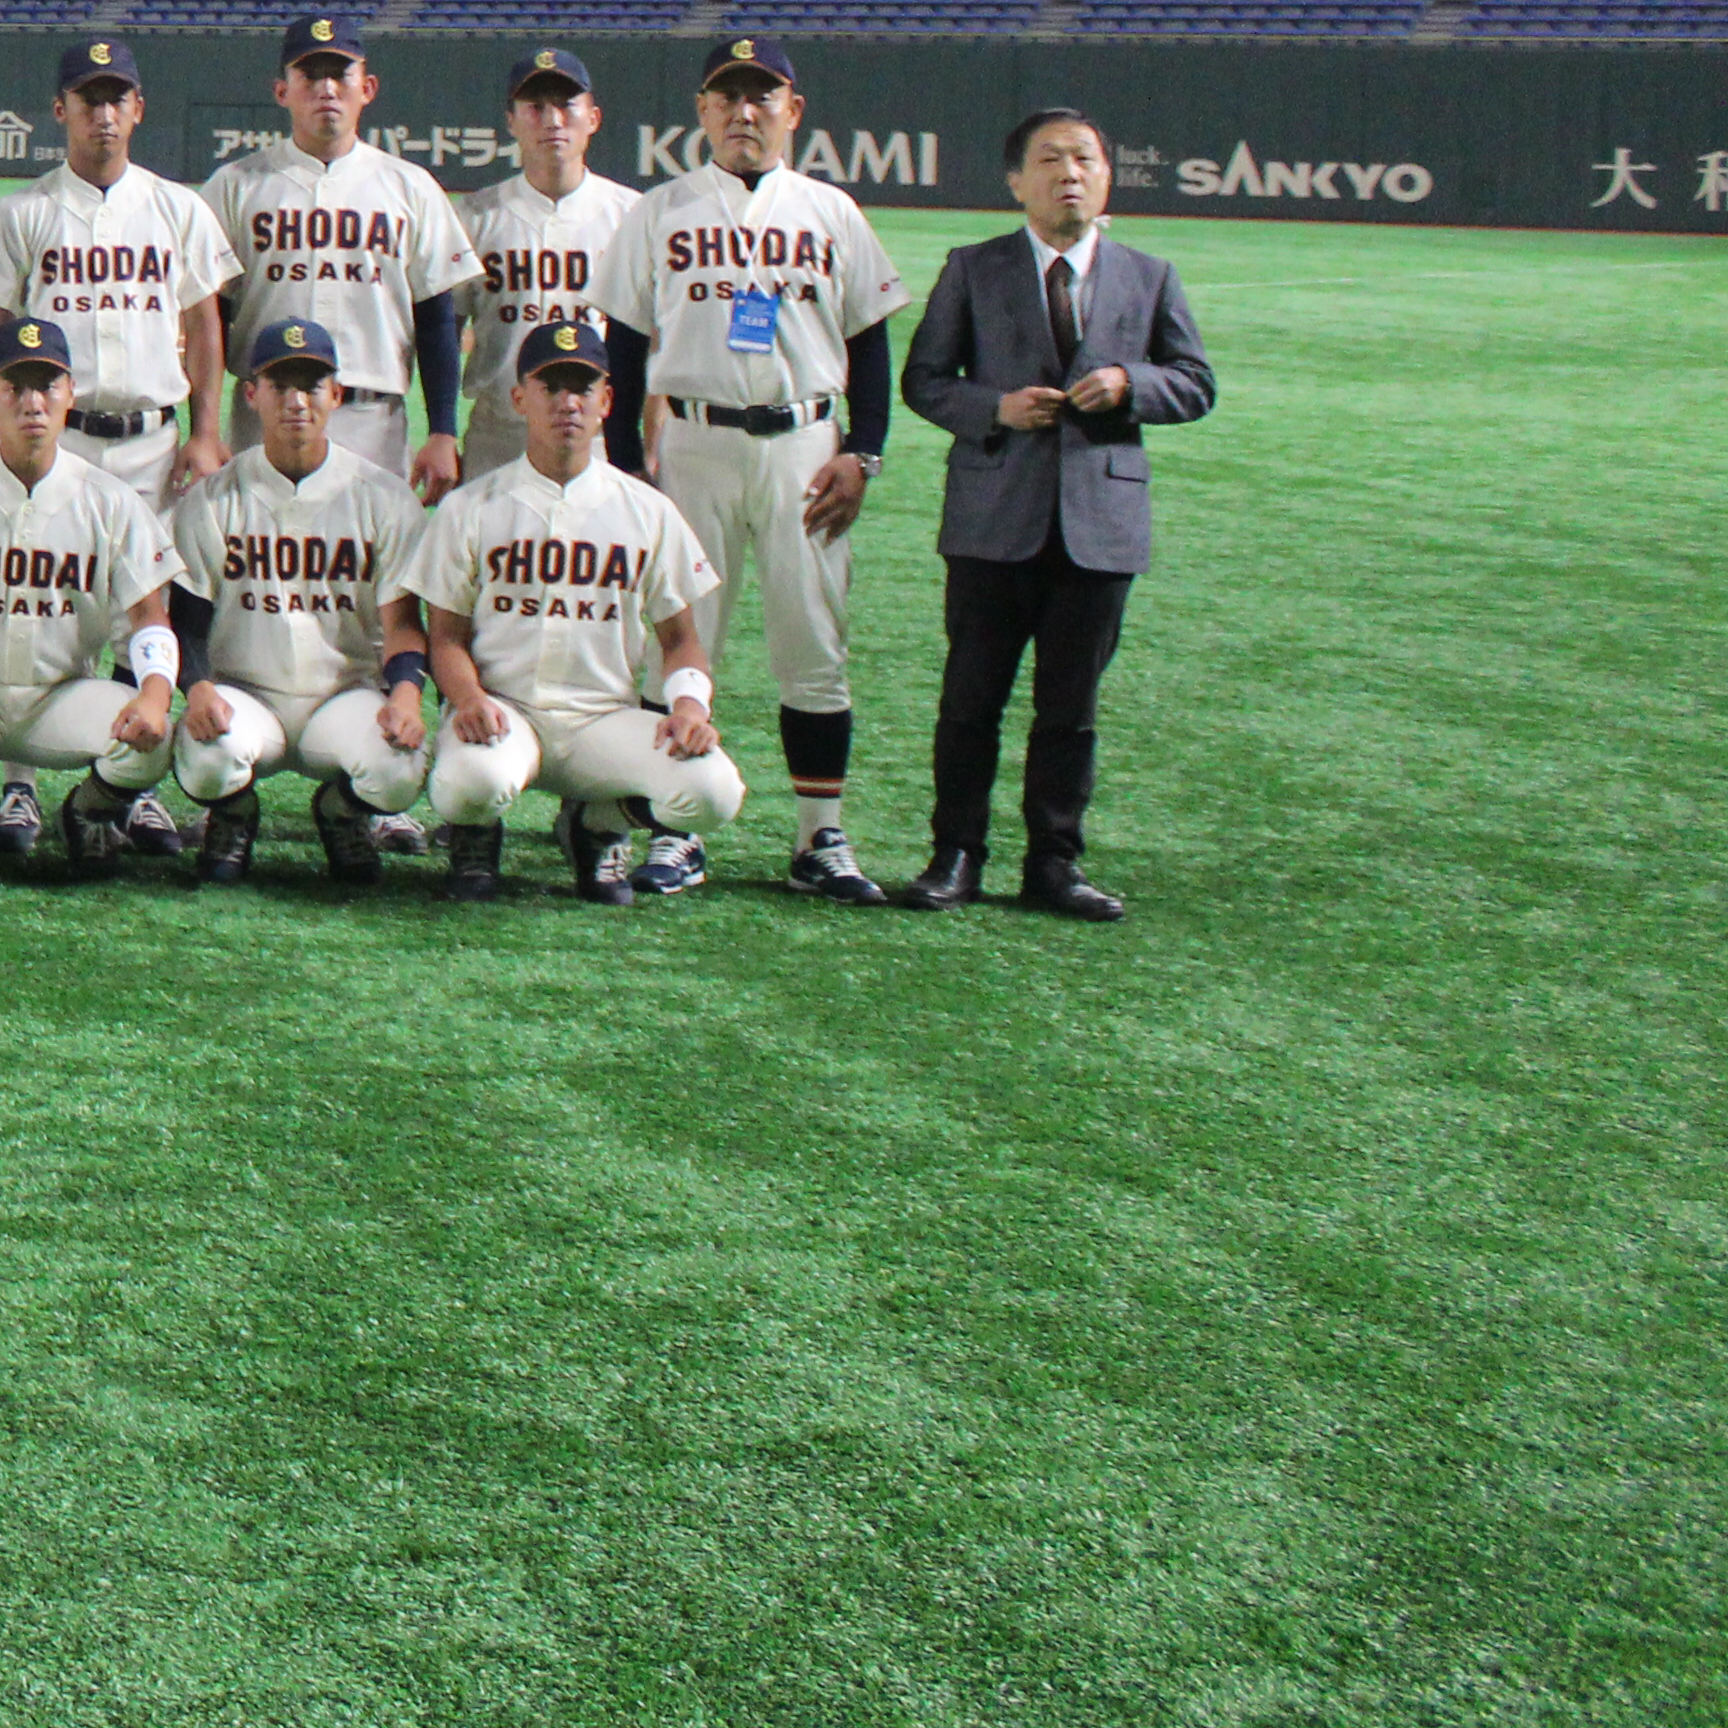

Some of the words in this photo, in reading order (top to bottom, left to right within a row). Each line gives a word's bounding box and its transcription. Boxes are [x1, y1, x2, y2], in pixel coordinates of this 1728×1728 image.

[1176, 139, 1434, 203] SANKYO
[252, 208, 405, 259] SHODAI
[667, 227, 836, 277] SHODAI
[40, 245, 172, 285] SHODAI
[266, 262, 384, 287] OSAKA
[51, 292, 164, 314] OSAKA
[223, 534, 375, 584] SHODAI
[487, 537, 646, 594] SHODAI
[239, 590, 357, 614] OSAKA
[492, 595, 621, 623] OSAKA
